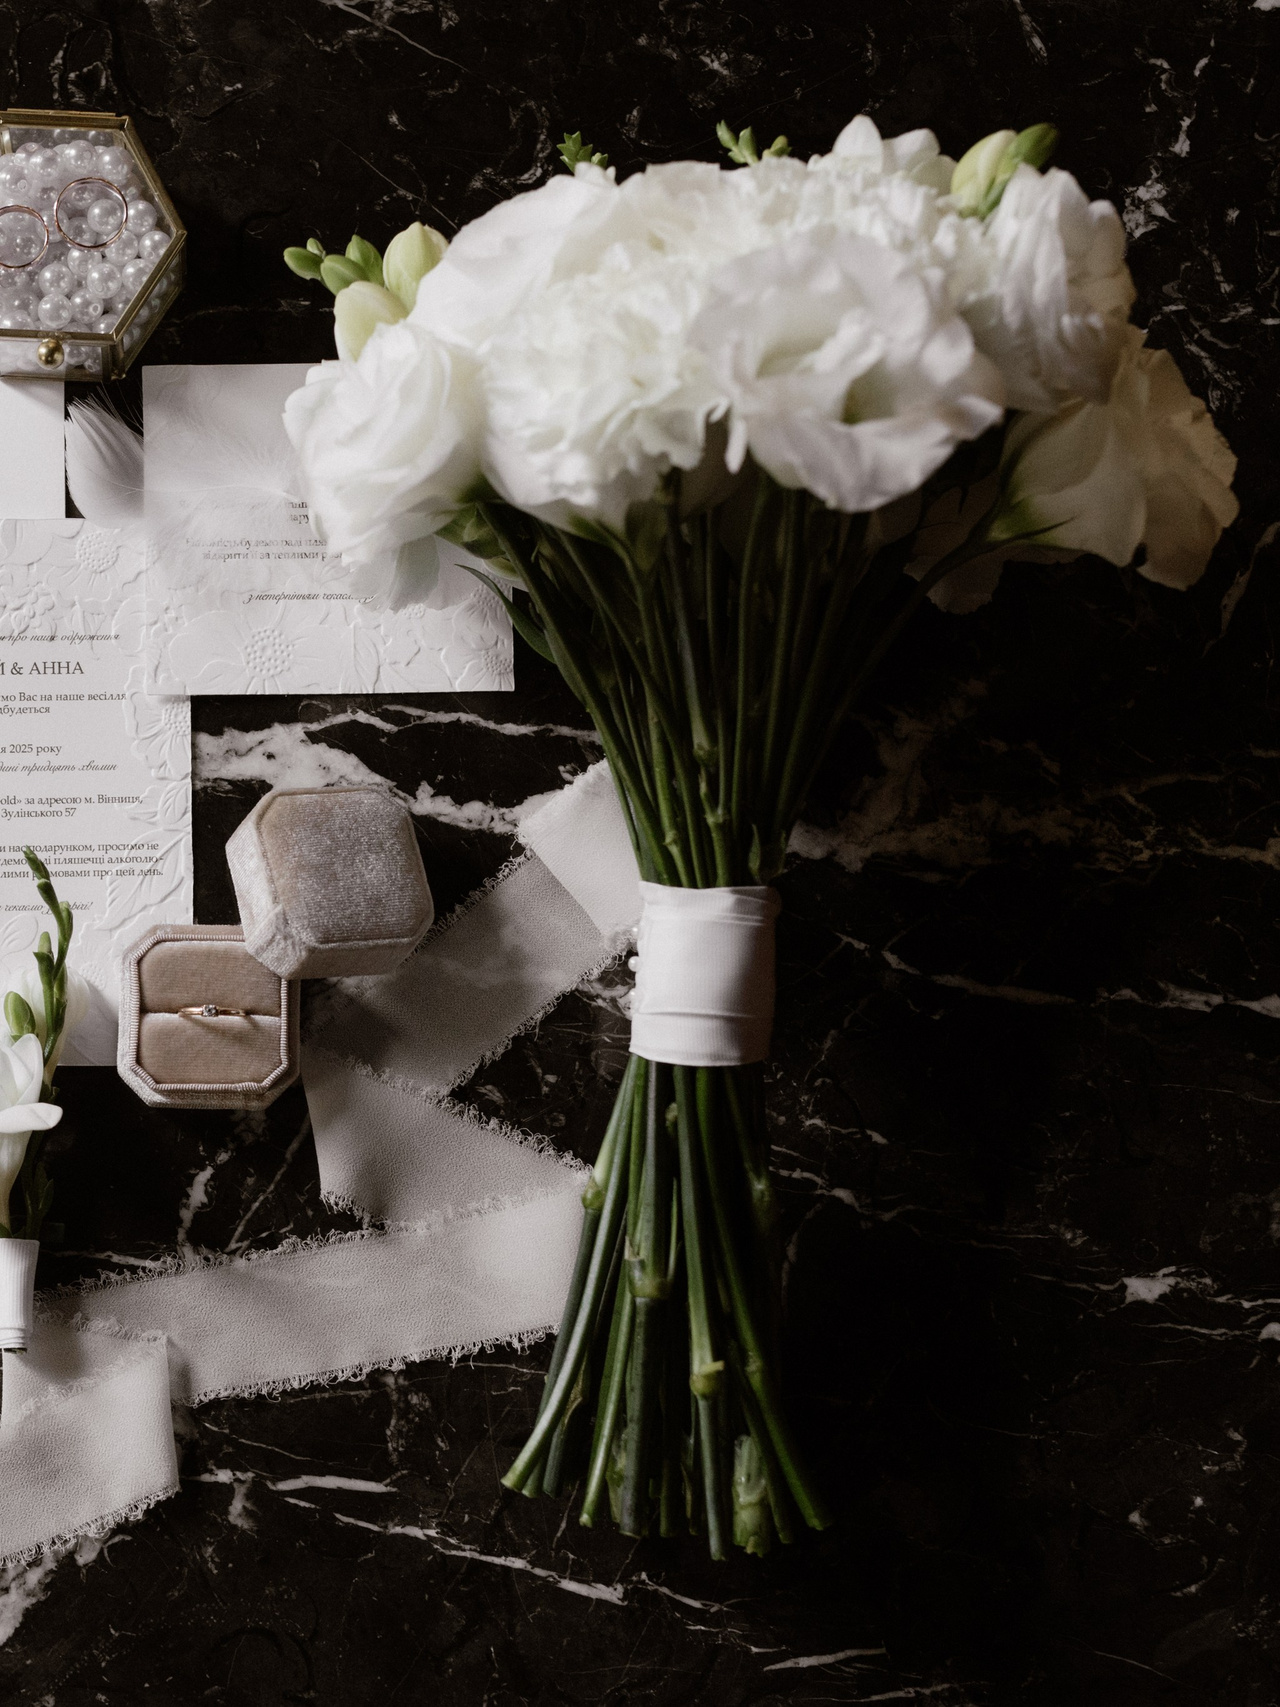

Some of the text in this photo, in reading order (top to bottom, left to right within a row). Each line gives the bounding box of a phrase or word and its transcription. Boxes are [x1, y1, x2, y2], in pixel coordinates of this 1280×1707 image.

[8, 632, 27, 646] про
[10, 661, 23, 675] &
[28, 661, 84, 675] АННА
[19, 692, 37, 701] Вас
[56, 693, 84, 701] наше
[88, 691, 126, 700] весілля
[9, 744, 33, 754] 2025
[36, 745, 62, 756] року
[24, 797, 35, 805] за
[37, 796, 82, 807] адресою
[98, 794, 143, 805] Вінниця,
[1, 808, 62, 821] Зулінського
[65, 808, 76, 817] 57
[98, 843, 144, 854] просимо
[147, 843, 159, 851] не
[32, 870, 90, 881] рмовами
[93, 869, 113, 880] про
[115, 867, 135, 877] цей
